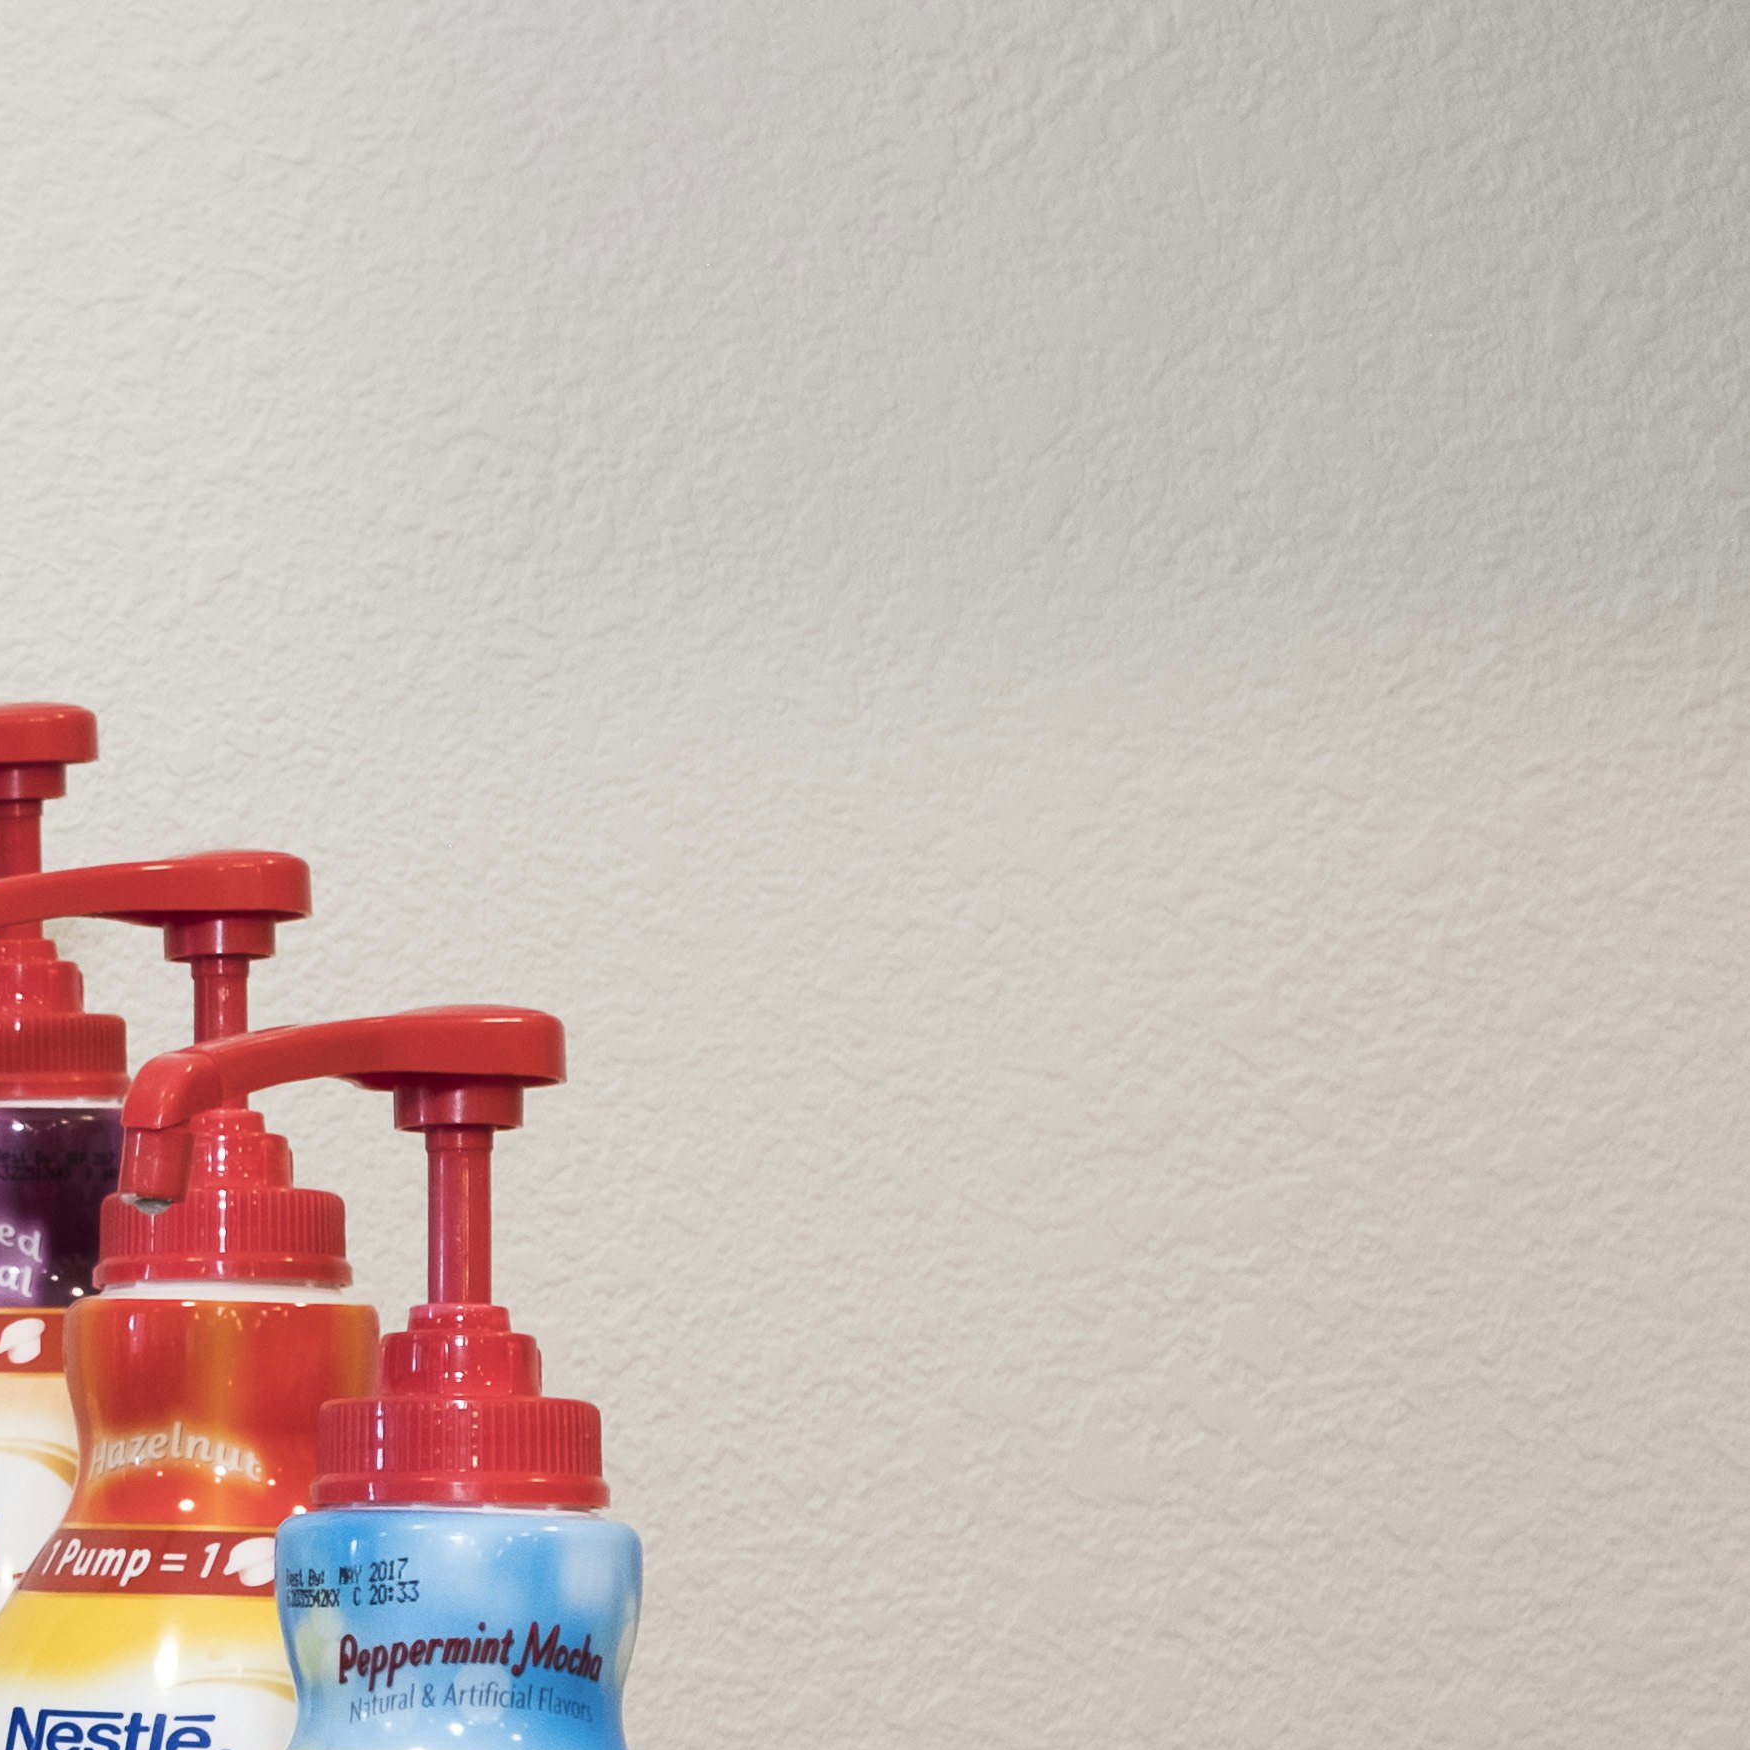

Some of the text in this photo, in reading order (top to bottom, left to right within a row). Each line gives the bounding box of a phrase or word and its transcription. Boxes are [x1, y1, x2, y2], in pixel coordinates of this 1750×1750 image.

[89, 1420, 263, 1484] Hazelnut
[41, 1538, 62, 1576] 1
[55, 1538, 152, 1587] Pump
[200, 1543, 221, 1579] 1
[368, 1557, 409, 1582] 2017
[353, 1586, 362, 1607] C
[368, 1580, 420, 1606] 20:33
[338, 1620, 603, 1691] Peppermint Mocha
[350, 1680, 593, 1724] Natural & Artificial Flavors
